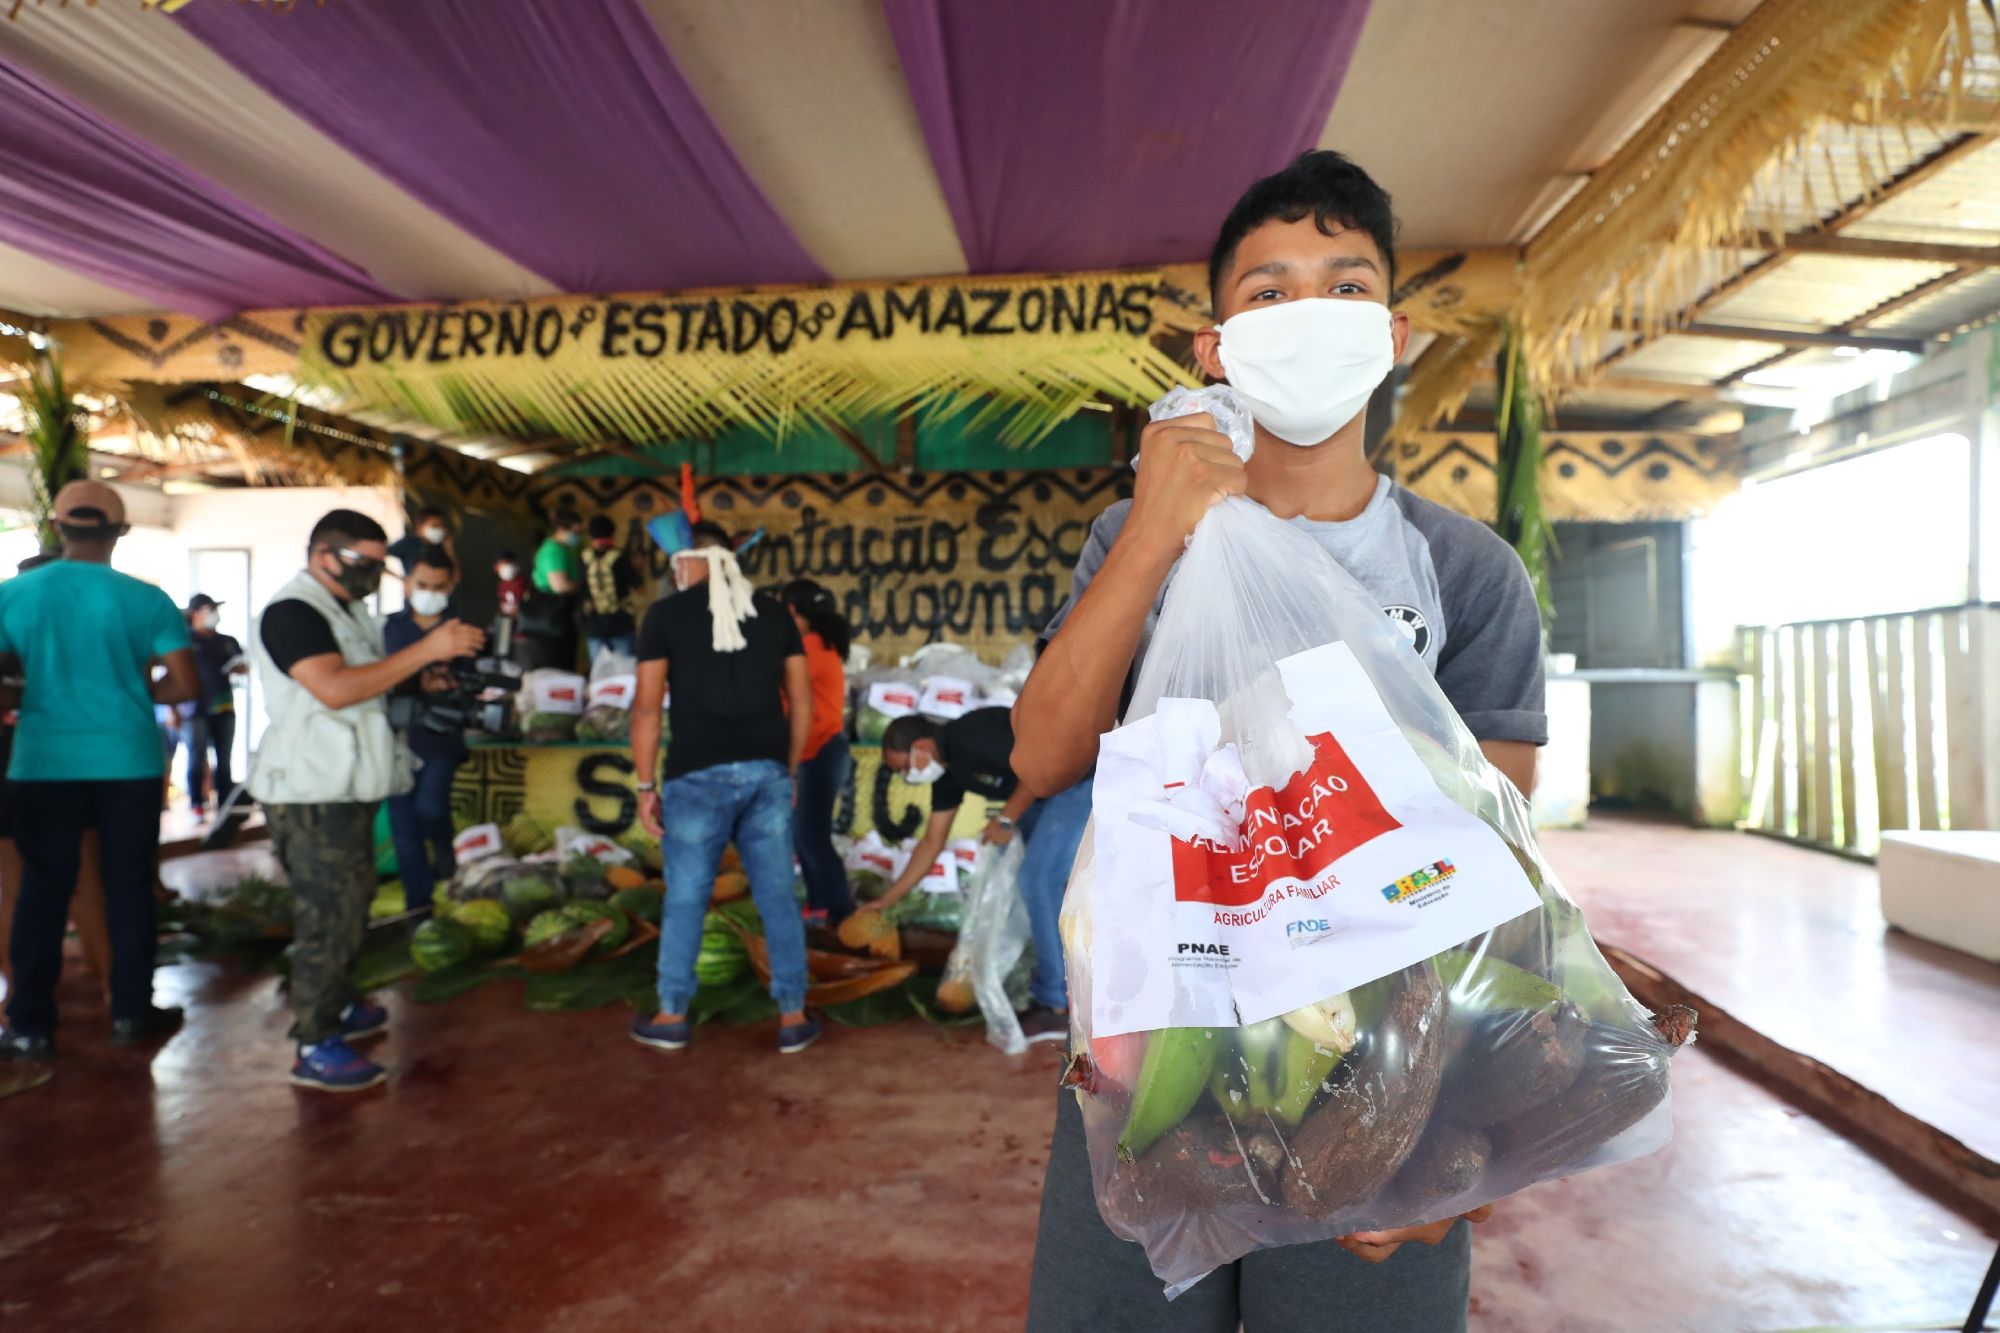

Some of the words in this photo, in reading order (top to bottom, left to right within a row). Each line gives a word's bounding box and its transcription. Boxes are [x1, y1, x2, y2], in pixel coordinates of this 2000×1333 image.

[321, 303, 563, 367] GOVERNO
[601, 297, 798, 357] ESTADO
[837, 284, 1155, 341] AMAZONAS
[1214, 888, 1285, 926] AGRICULTURA
[1286, 874, 1341, 899] FAMILIAR
[1286, 919, 1331, 937] FNDE
[1177, 943, 1230, 956] PNAE
